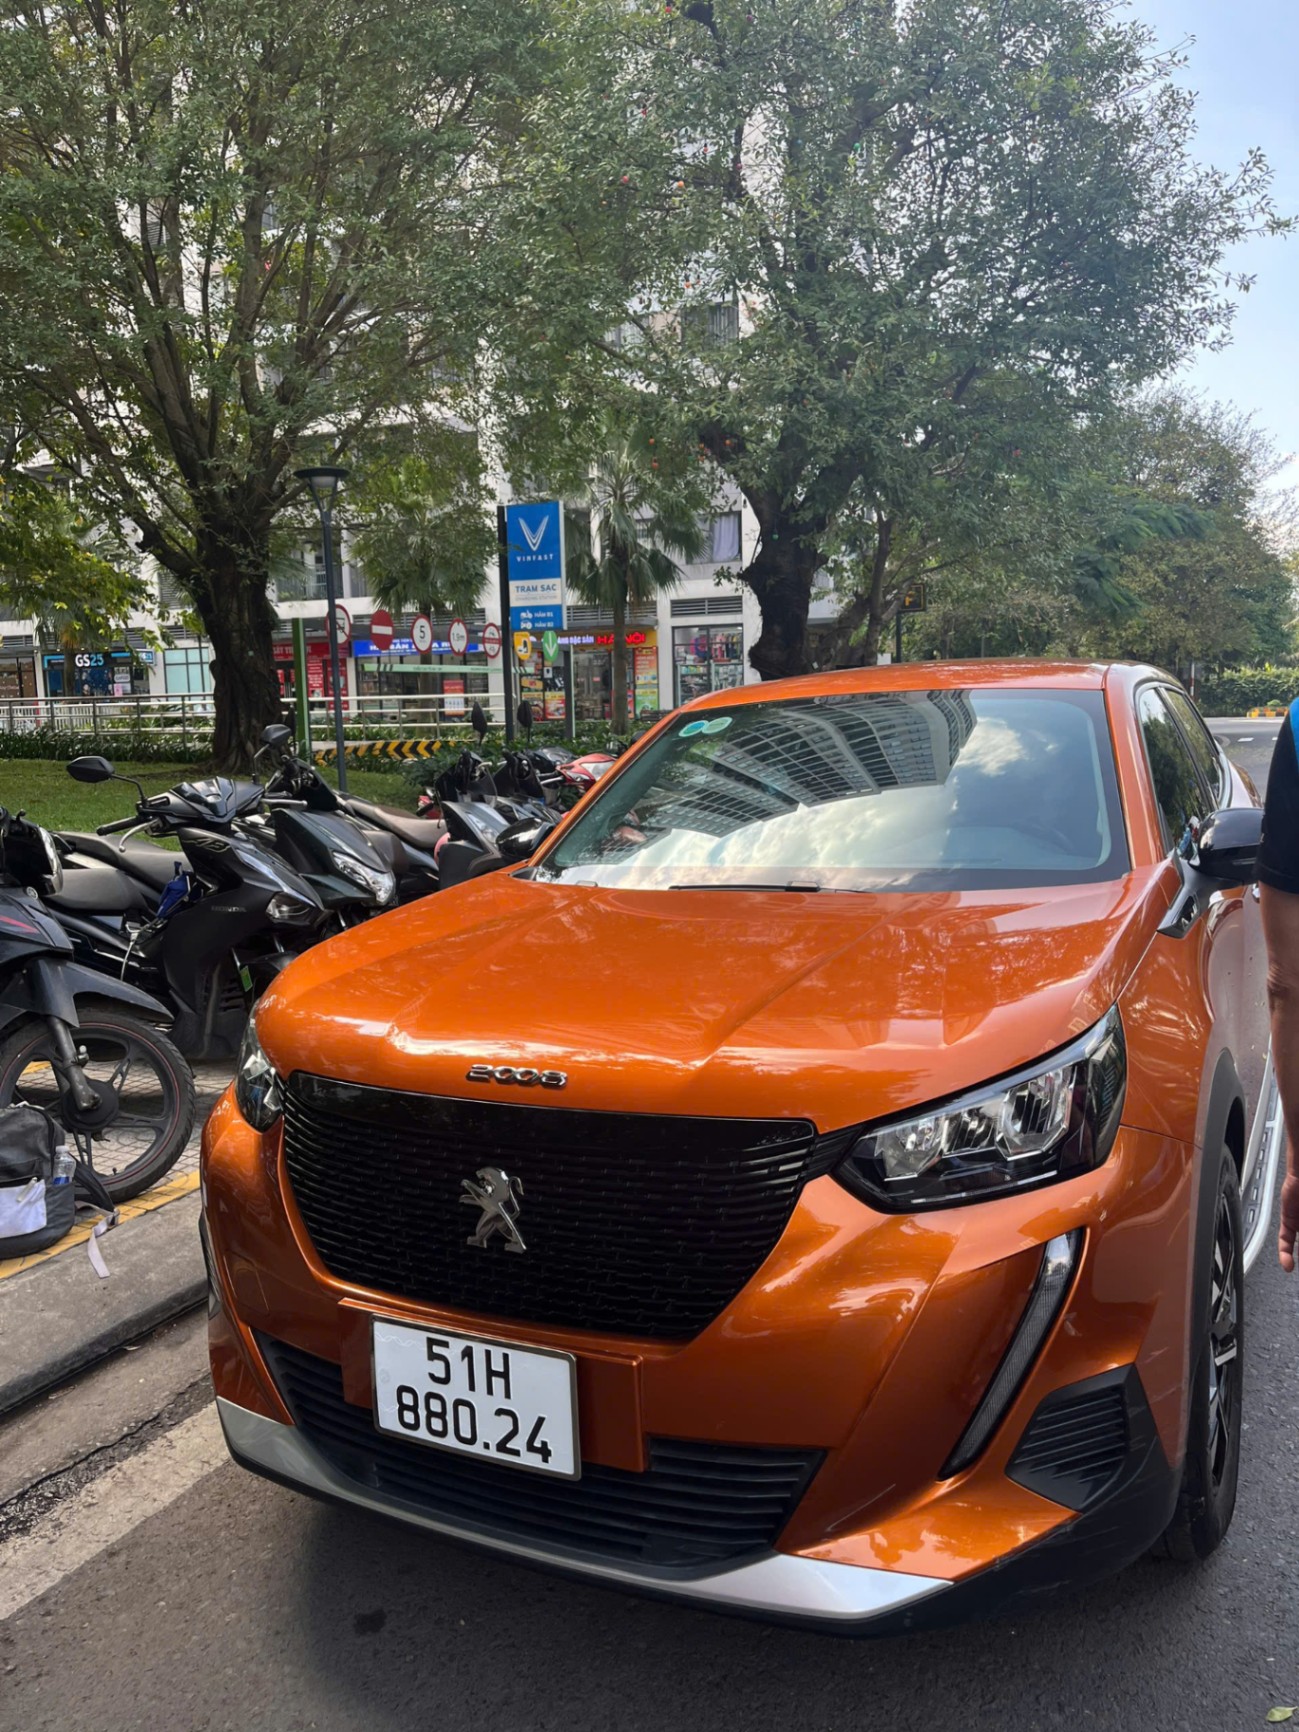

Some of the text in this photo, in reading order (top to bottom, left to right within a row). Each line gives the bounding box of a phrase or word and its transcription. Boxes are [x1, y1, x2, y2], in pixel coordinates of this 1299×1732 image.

[516, 553, 554, 562] VINFAST
[419, 626, 426, 639] 5
[75, 654, 104, 667] GS25
[211, 905, 247, 913] HONDA
[466, 1064, 568, 1091] 2008
[426, 1336, 512, 1400] 51H
[396, 1384, 552, 1464] 880.24
